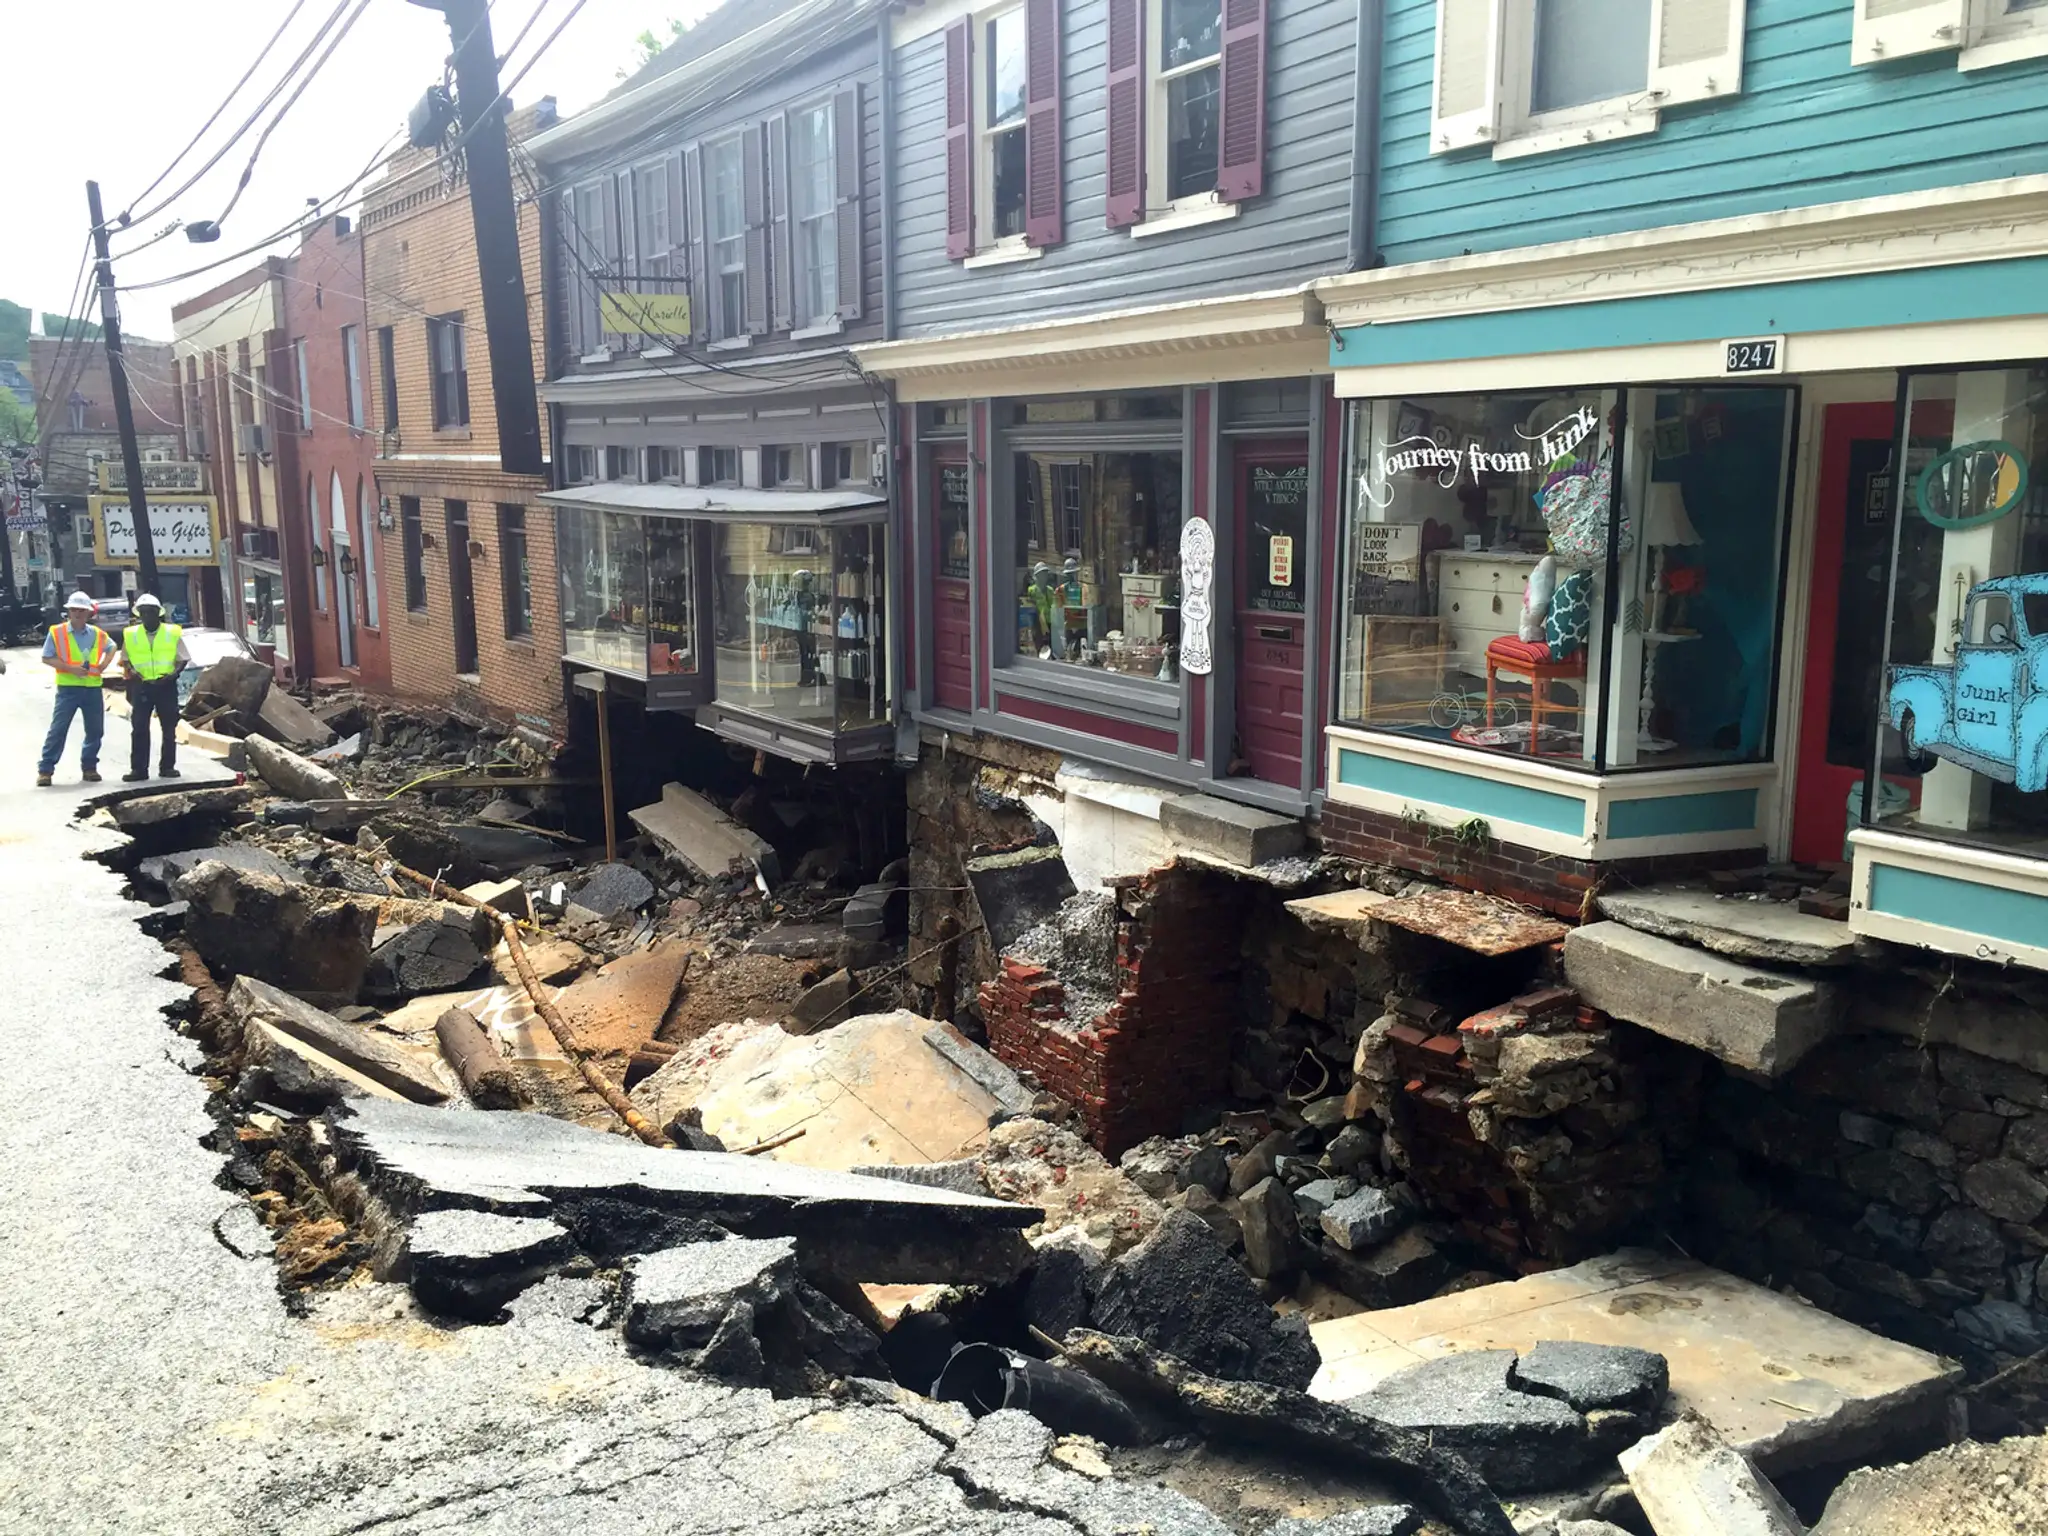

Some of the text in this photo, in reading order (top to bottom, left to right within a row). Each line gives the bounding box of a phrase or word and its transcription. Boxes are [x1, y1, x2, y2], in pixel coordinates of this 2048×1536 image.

[1728, 344, 1775, 369] 8247
[1358, 404, 1598, 510] A Journey from Junk
[172, 520, 206, 543] Gifts
[1364, 527, 1402, 539] DON'T
[1363, 540, 1387, 550] LOOK
[1363, 552, 1387, 562] BACK
[1961, 684, 2012, 703] Junk
[1957, 707, 1997, 726] Girl
